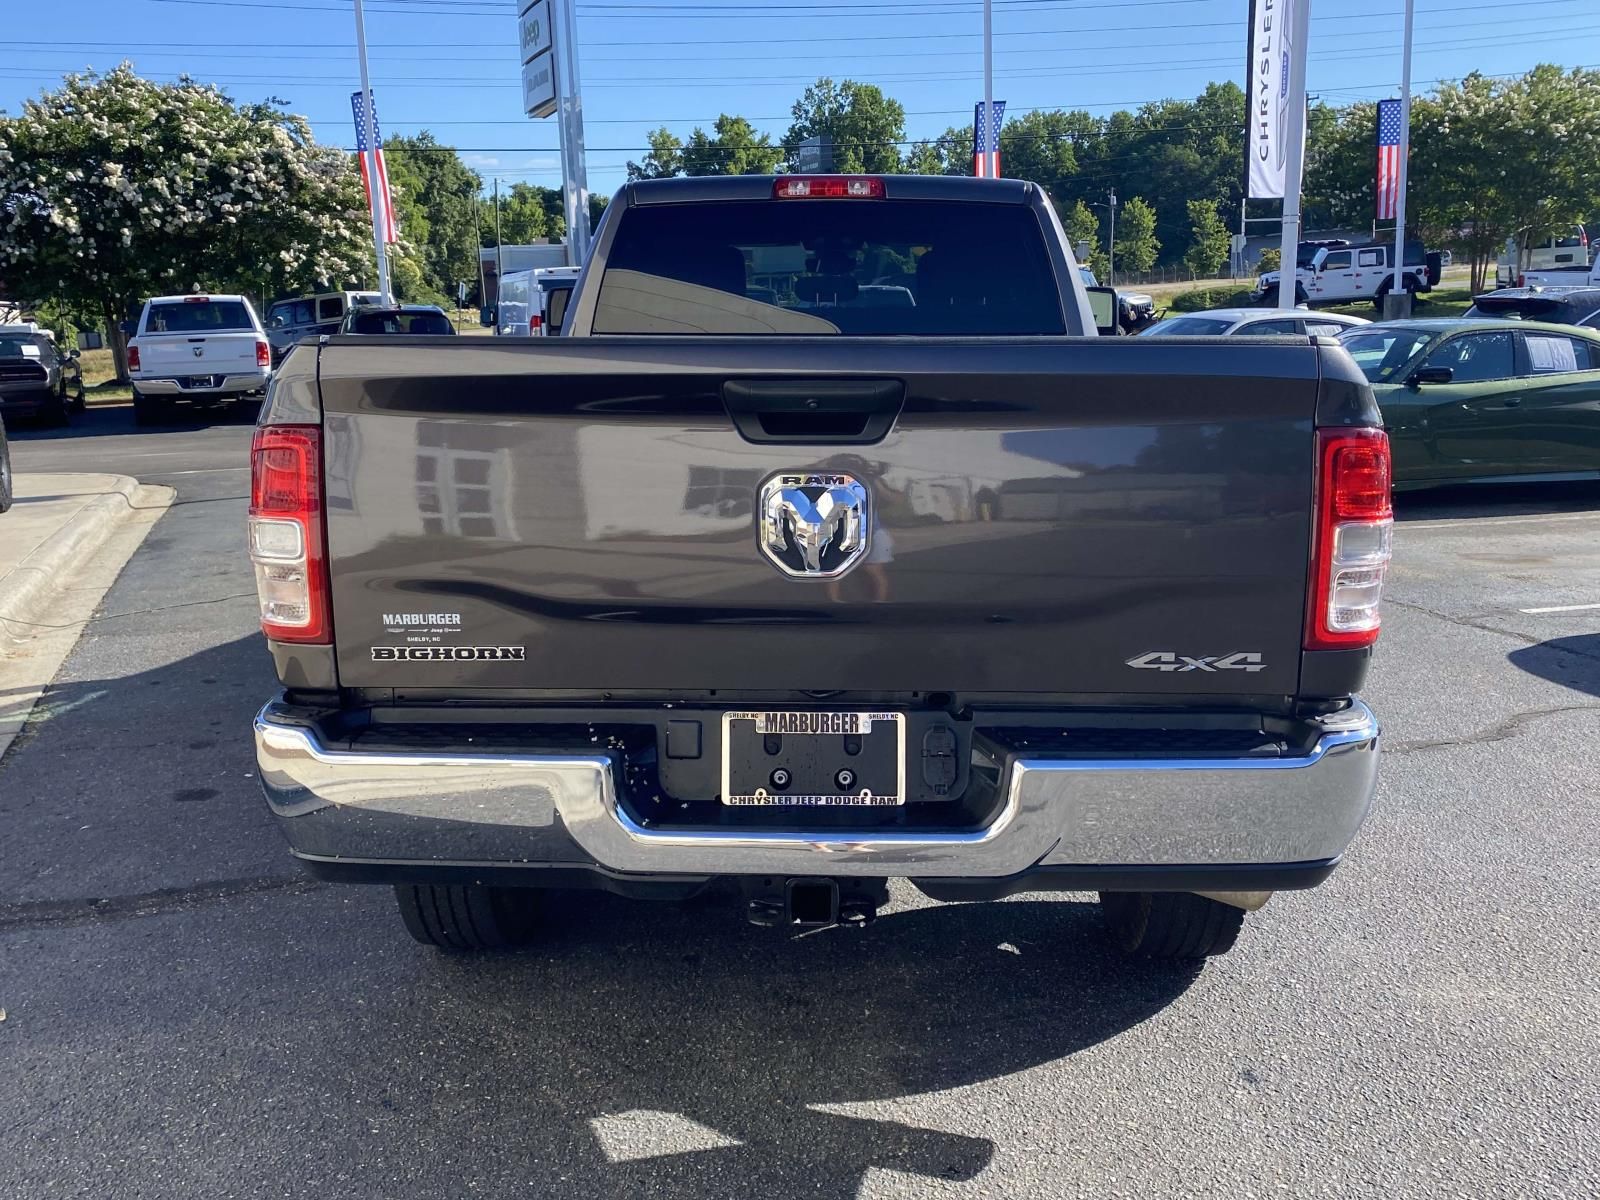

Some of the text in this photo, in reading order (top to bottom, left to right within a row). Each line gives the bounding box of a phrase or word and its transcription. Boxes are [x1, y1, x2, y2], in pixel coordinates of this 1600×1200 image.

[1259, 0, 1273, 162] CHRYSLER
[782, 476, 845, 485] RAM
[382, 613, 461, 625] MARBURGER
[371, 646, 526, 661] BIGHORN
[764, 712, 860, 733] MARBURGER
[729, 796, 898, 805] CHRYSLER JEEP DODGE RAM
